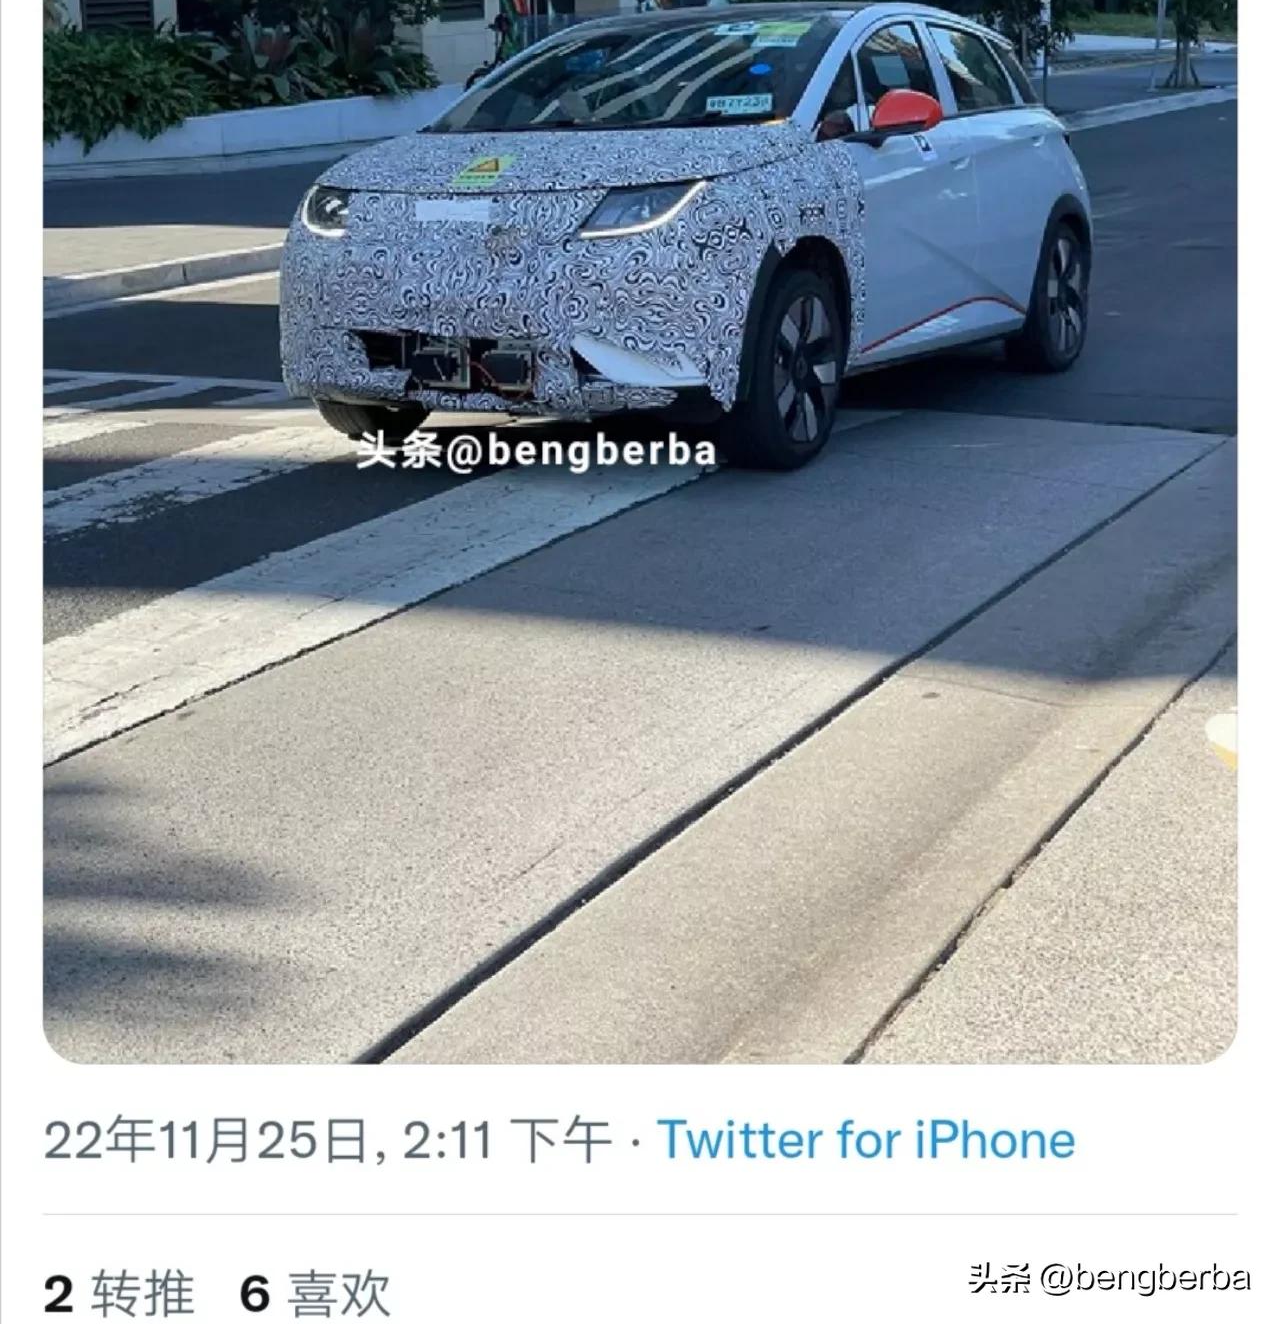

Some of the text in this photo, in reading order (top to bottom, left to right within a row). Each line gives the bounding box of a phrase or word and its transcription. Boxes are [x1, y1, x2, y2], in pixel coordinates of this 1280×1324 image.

[403, 1120, 490, 1159] 2:11
[509, 1115, 613, 1164] 下午
[657, 1118, 824, 1160] Twitter
[836, 1118, 902, 1160] for
[916, 1118, 1076, 1159] iPhone
[44, 1269, 391, 1318] 2 转推 6 喜欢
